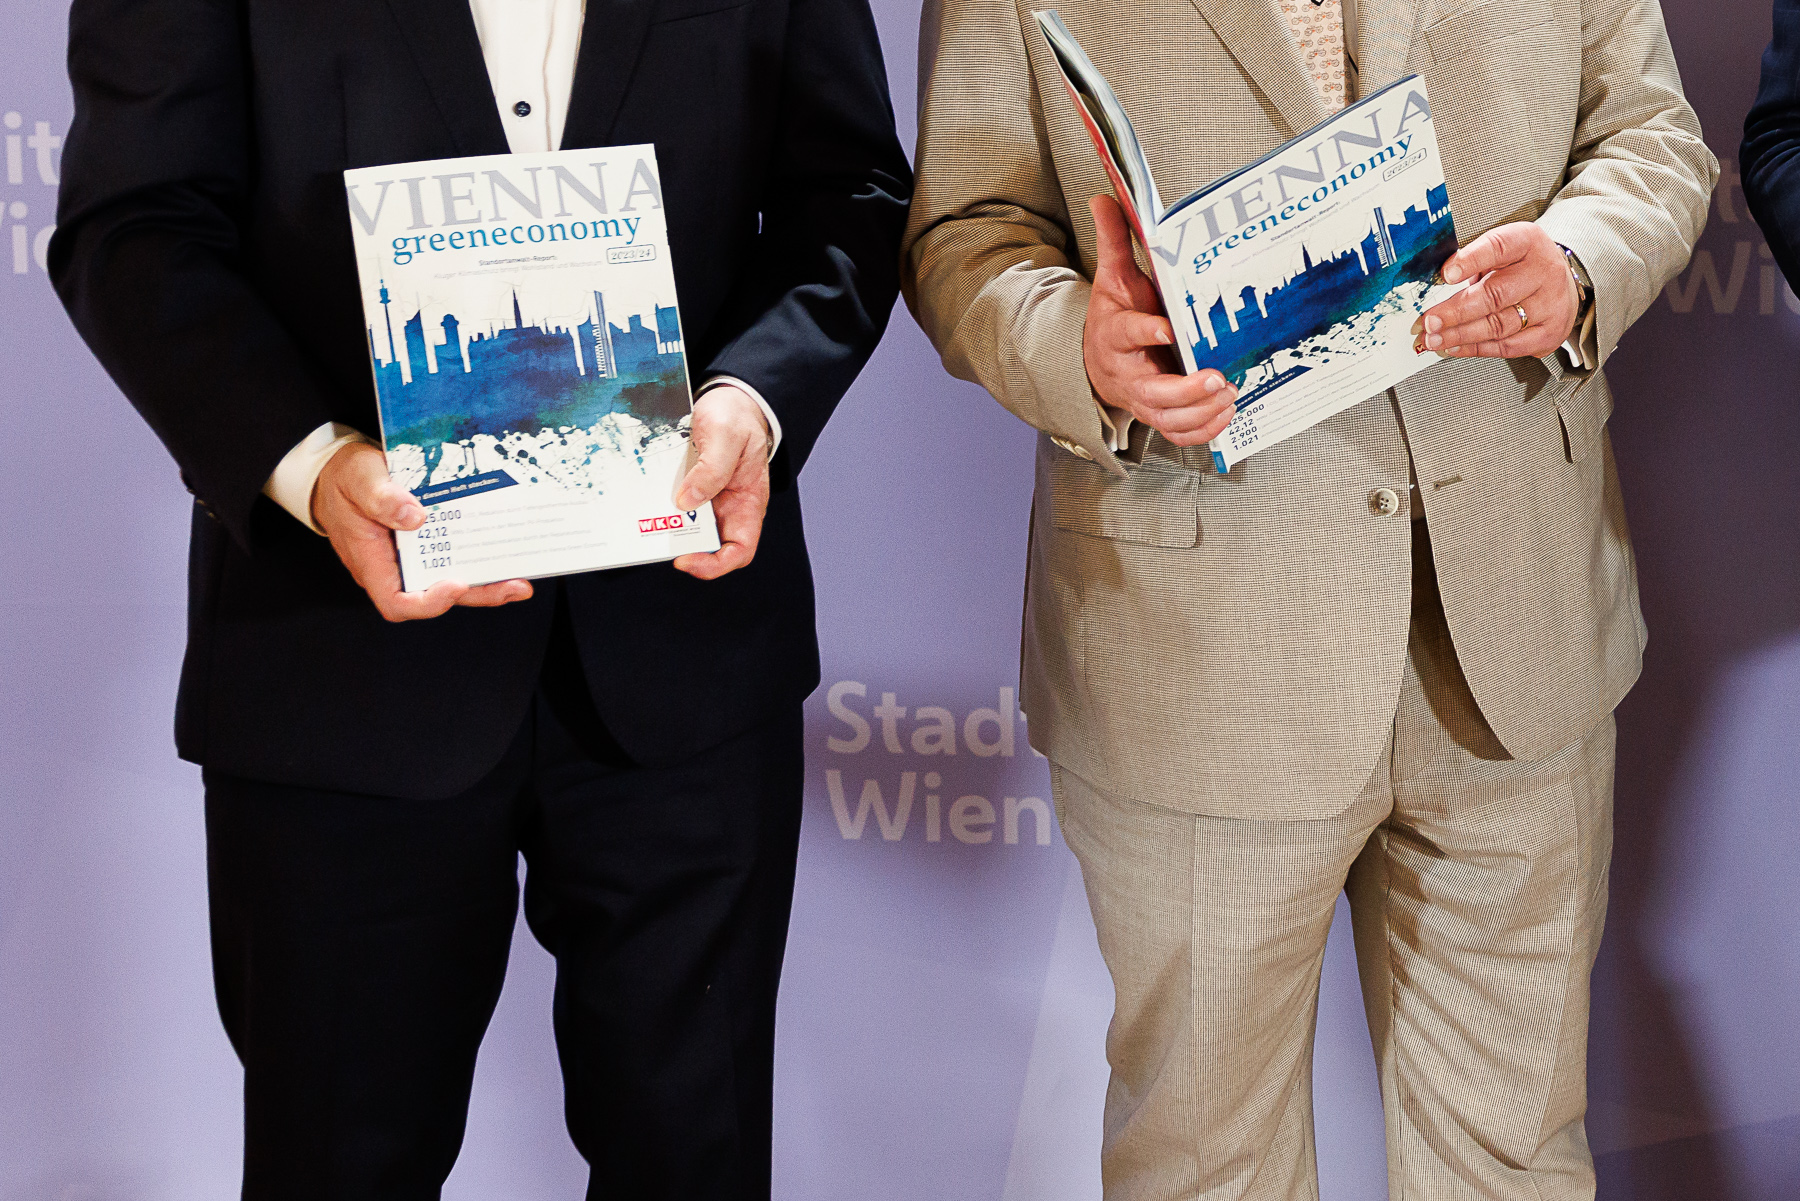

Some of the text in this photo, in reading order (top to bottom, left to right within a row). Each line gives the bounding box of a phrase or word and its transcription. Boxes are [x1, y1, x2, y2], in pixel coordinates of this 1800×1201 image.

[347, 158, 661, 236] VIENNA
[1150, 90, 1432, 267] VIENNA
[1193, 133, 1413, 275] greeneconomy
[392, 217, 641, 265] greeneconomy
[418, 526, 448, 540] 42,12
[420, 541, 452, 555] 2.900
[639, 515, 682, 532] WKO
[422, 556, 452, 570] 1.021
[826, 680, 1049, 758] Stad
[825, 770, 1051, 846] Wien
